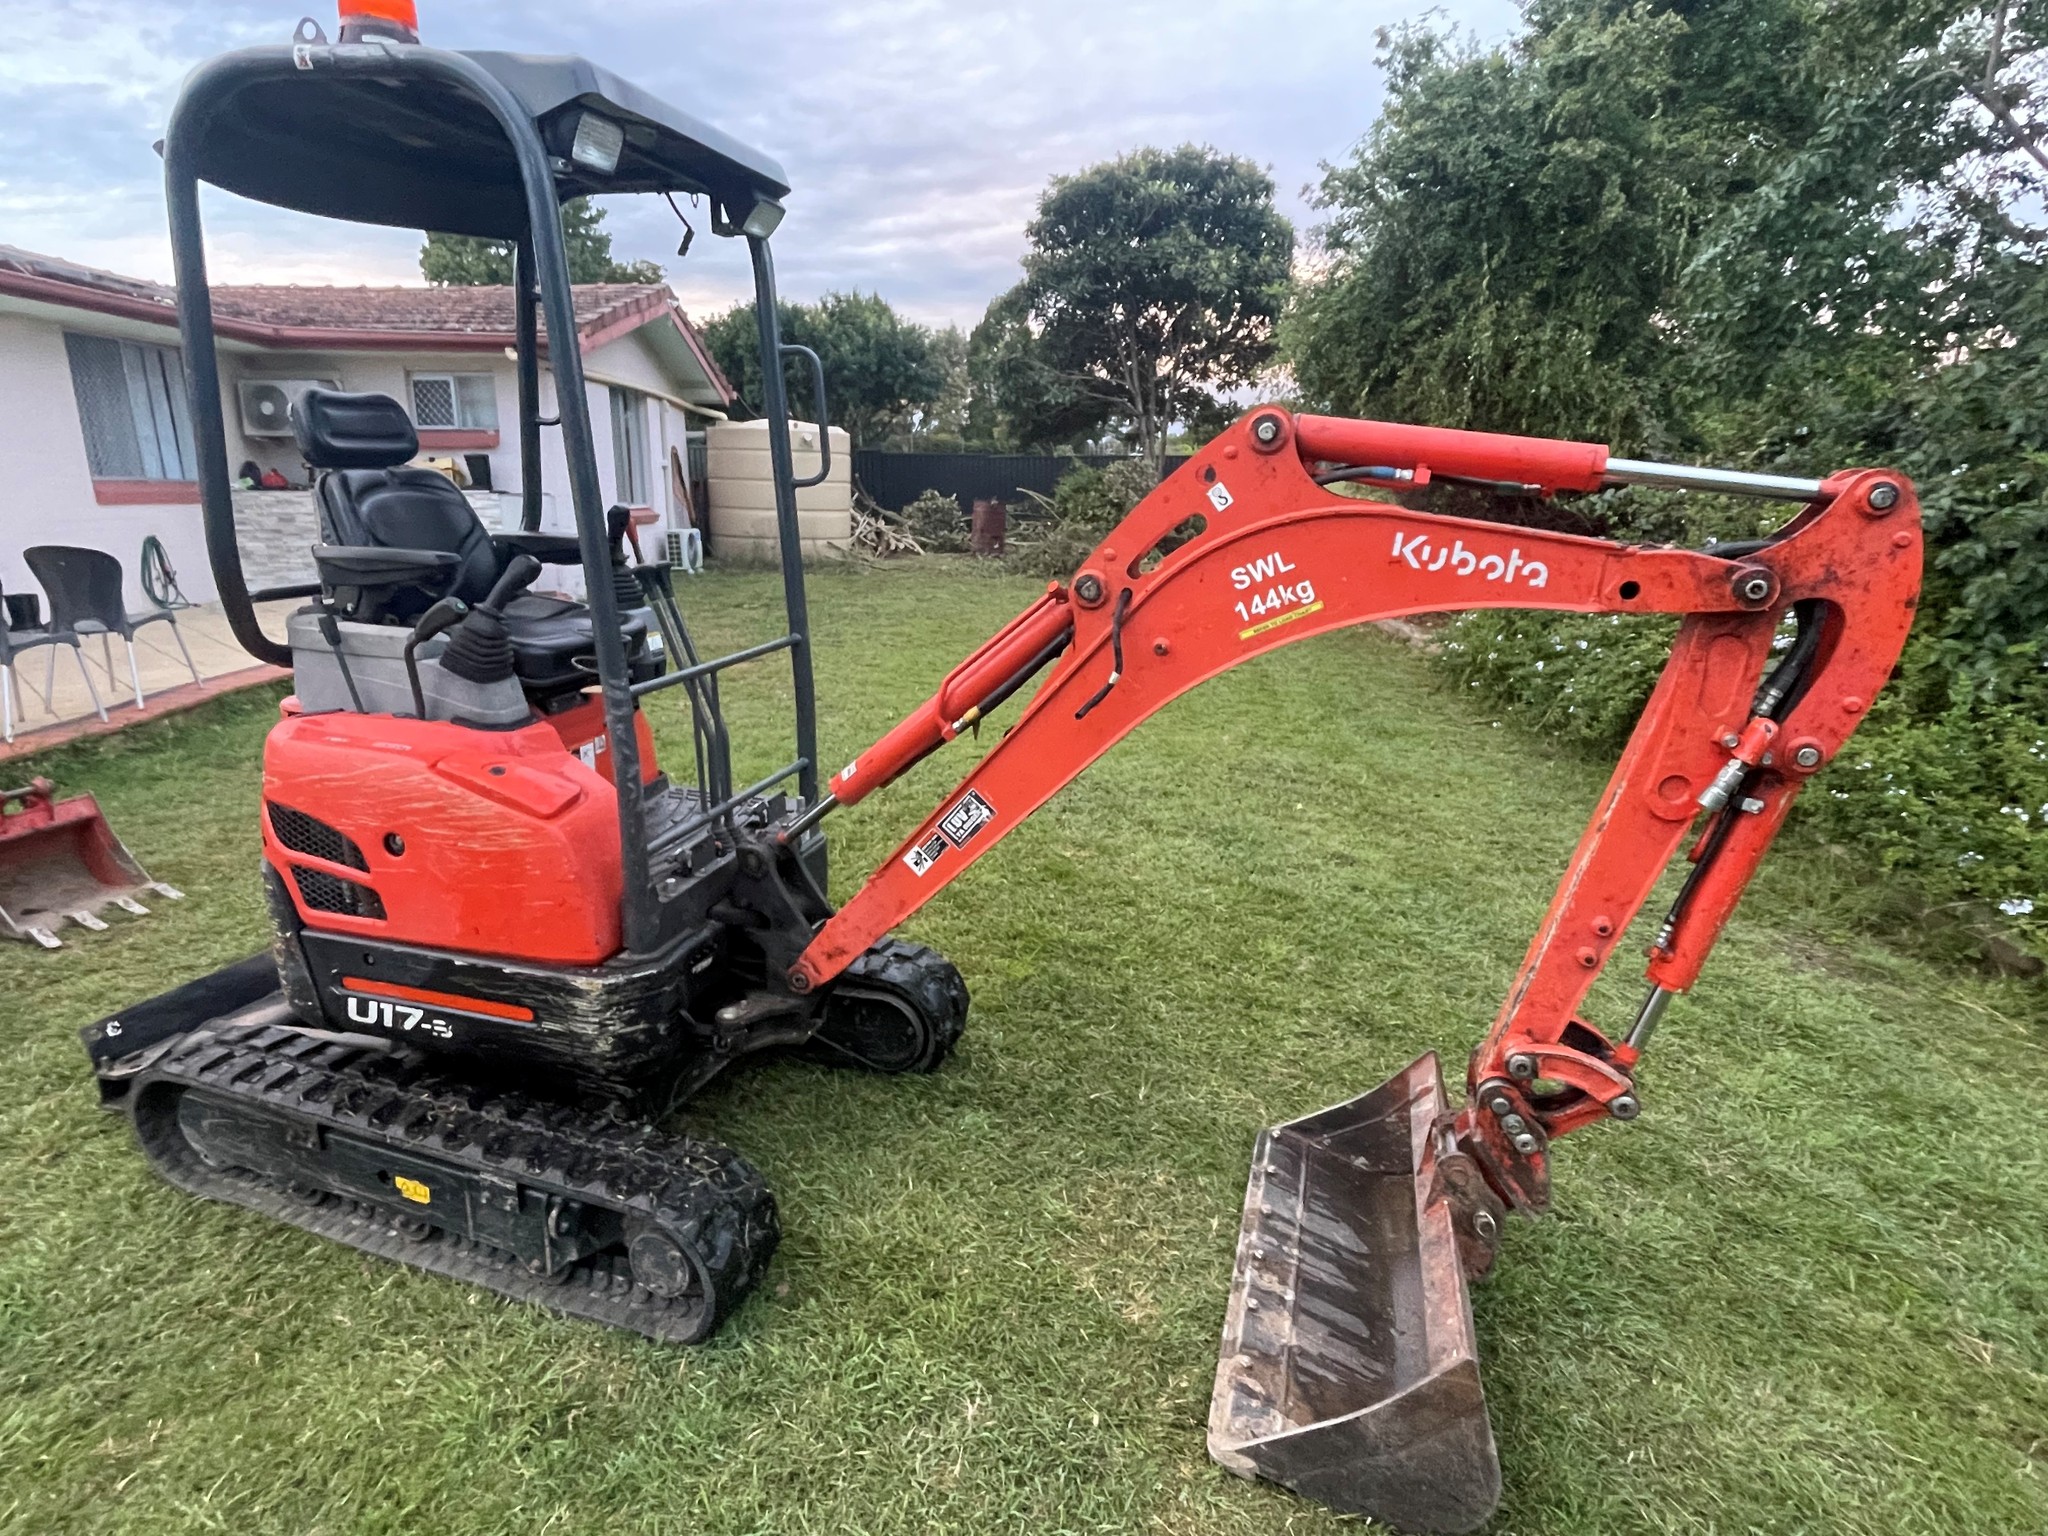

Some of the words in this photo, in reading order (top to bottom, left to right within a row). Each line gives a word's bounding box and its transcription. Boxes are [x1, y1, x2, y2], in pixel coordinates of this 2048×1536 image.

[1231, 552, 1296, 590] SWL
[1391, 532, 1549, 588] Kubota
[1235, 580, 1315, 621] 144kg
[946, 808, 969, 833] LUV
